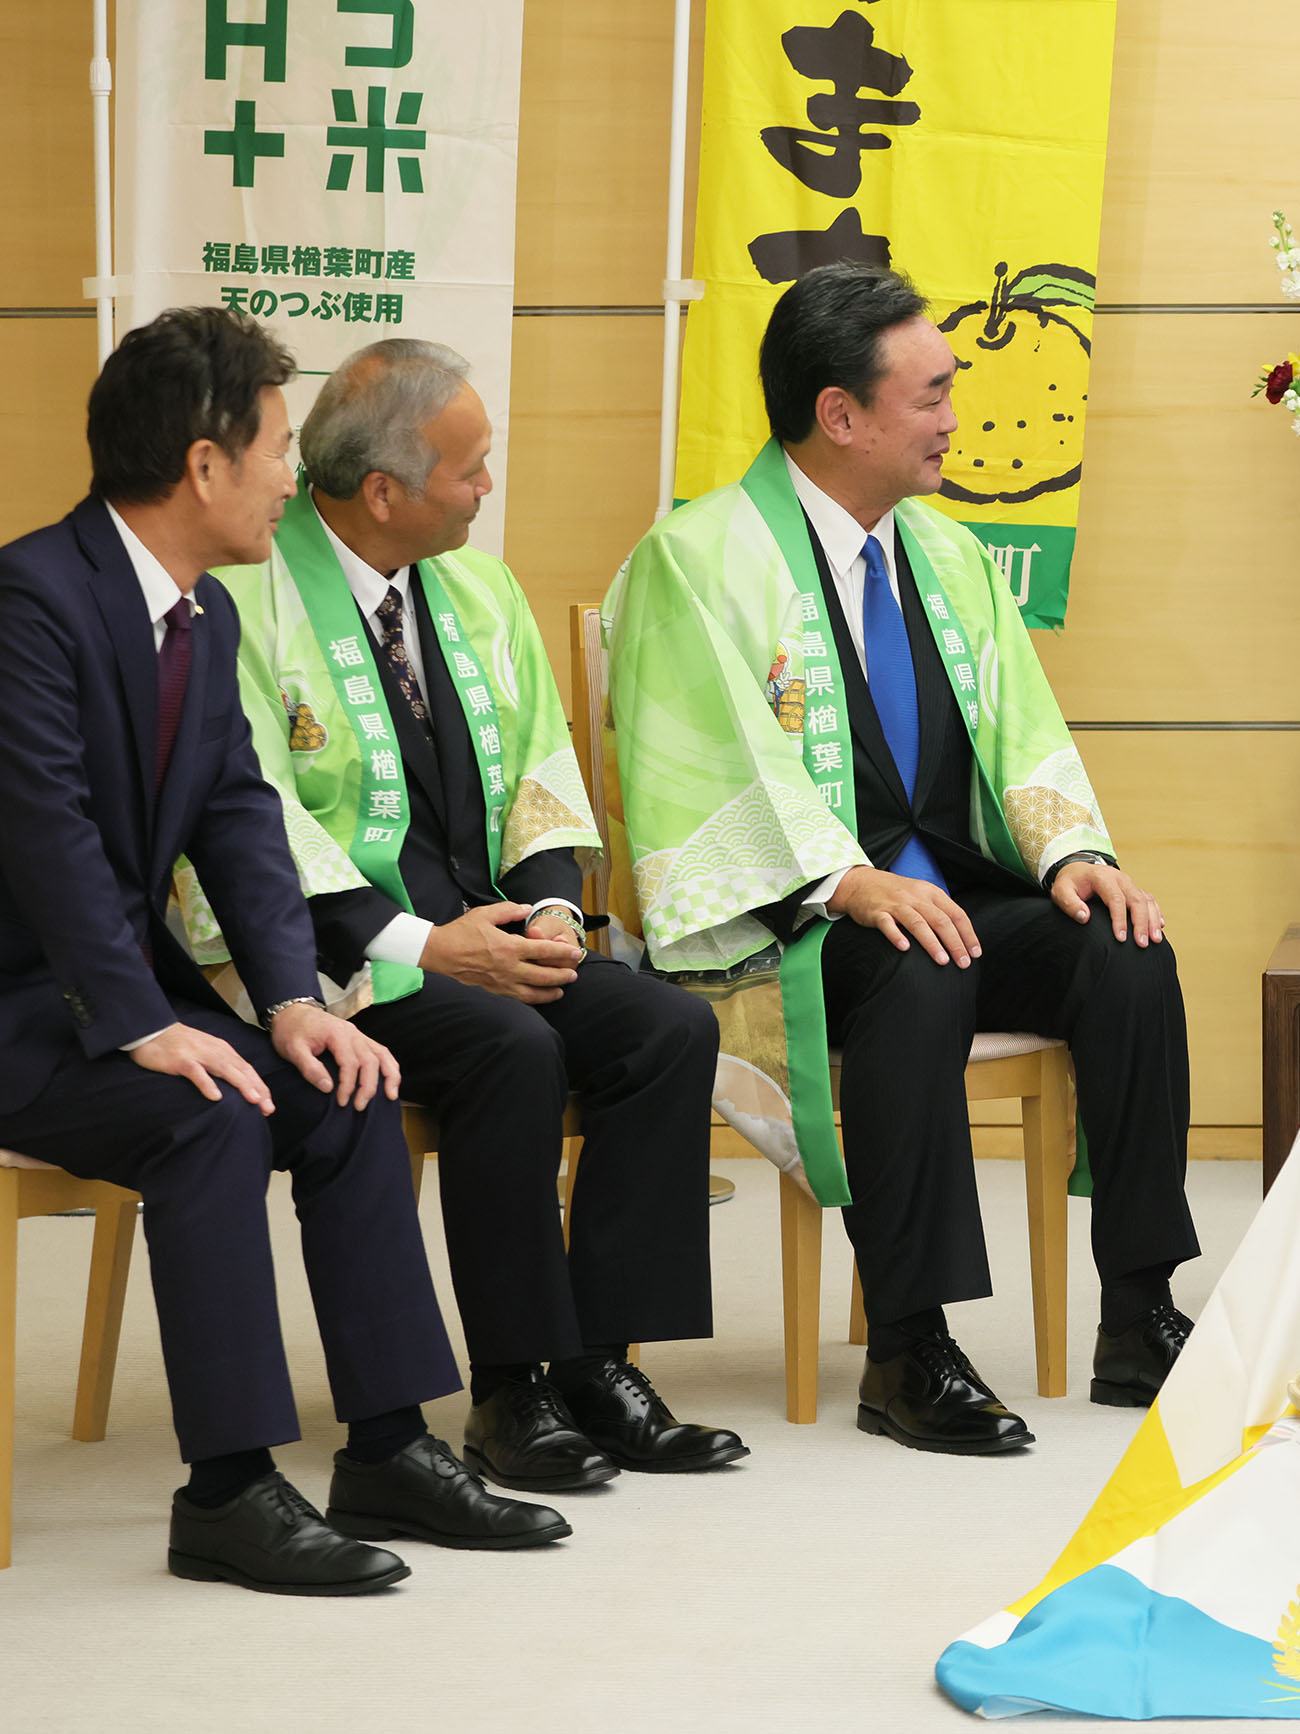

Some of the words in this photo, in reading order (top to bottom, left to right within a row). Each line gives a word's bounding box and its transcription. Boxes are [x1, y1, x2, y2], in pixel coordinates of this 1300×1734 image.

[202, 242, 415, 280] 福島県楢葉町産
[220, 287, 403, 324] 天のつぶ使用
[328, 635, 402, 842] 福島県楢葉町
